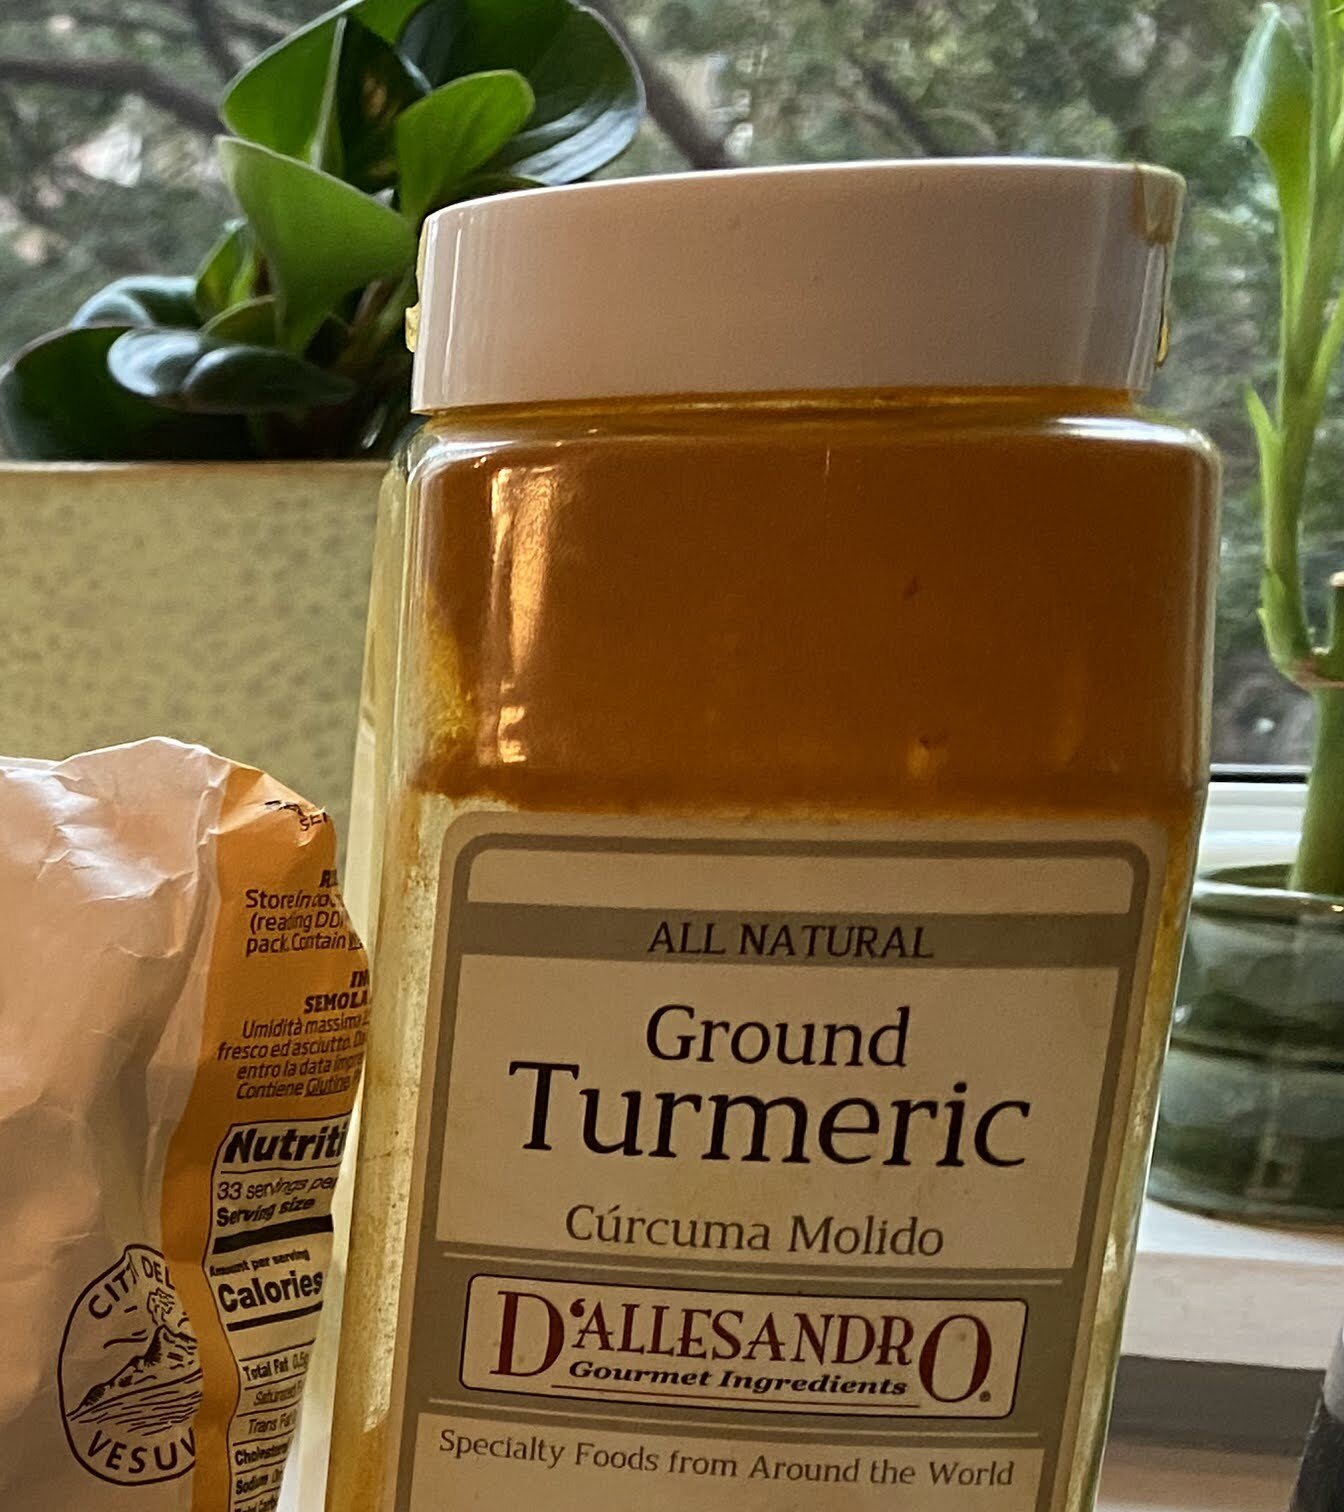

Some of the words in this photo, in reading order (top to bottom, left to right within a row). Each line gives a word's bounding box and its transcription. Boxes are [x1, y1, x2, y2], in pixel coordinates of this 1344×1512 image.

[647, 921, 726, 957] ALL
[738, 923, 934, 960] NATURAL
[217, 1041, 268, 1061] fresco
[646, 1002, 911, 1069] Ground
[508, 1059, 1031, 1168] Turmeric
[217, 1181, 242, 1200] 33
[216, 1203, 276, 1228] Serving
[278, 1196, 317, 1214] size
[566, 1203, 770, 1252] Cúrcuma
[788, 1214, 945, 1257] Molido
[217, 1270, 323, 1313] Calories
[243, 1361, 272, 1382] Total
[568, 1359, 711, 1388] Gourmet
[718, 1369, 908, 1399] Ingredients
[438, 1428, 566, 1467] Specialty
[576, 1443, 659, 1474] Foods
[668, 1450, 738, 1479] from
[747, 1455, 859, 1484] Around
[870, 1458, 915, 1485] the
[929, 1460, 1015, 1488] World
